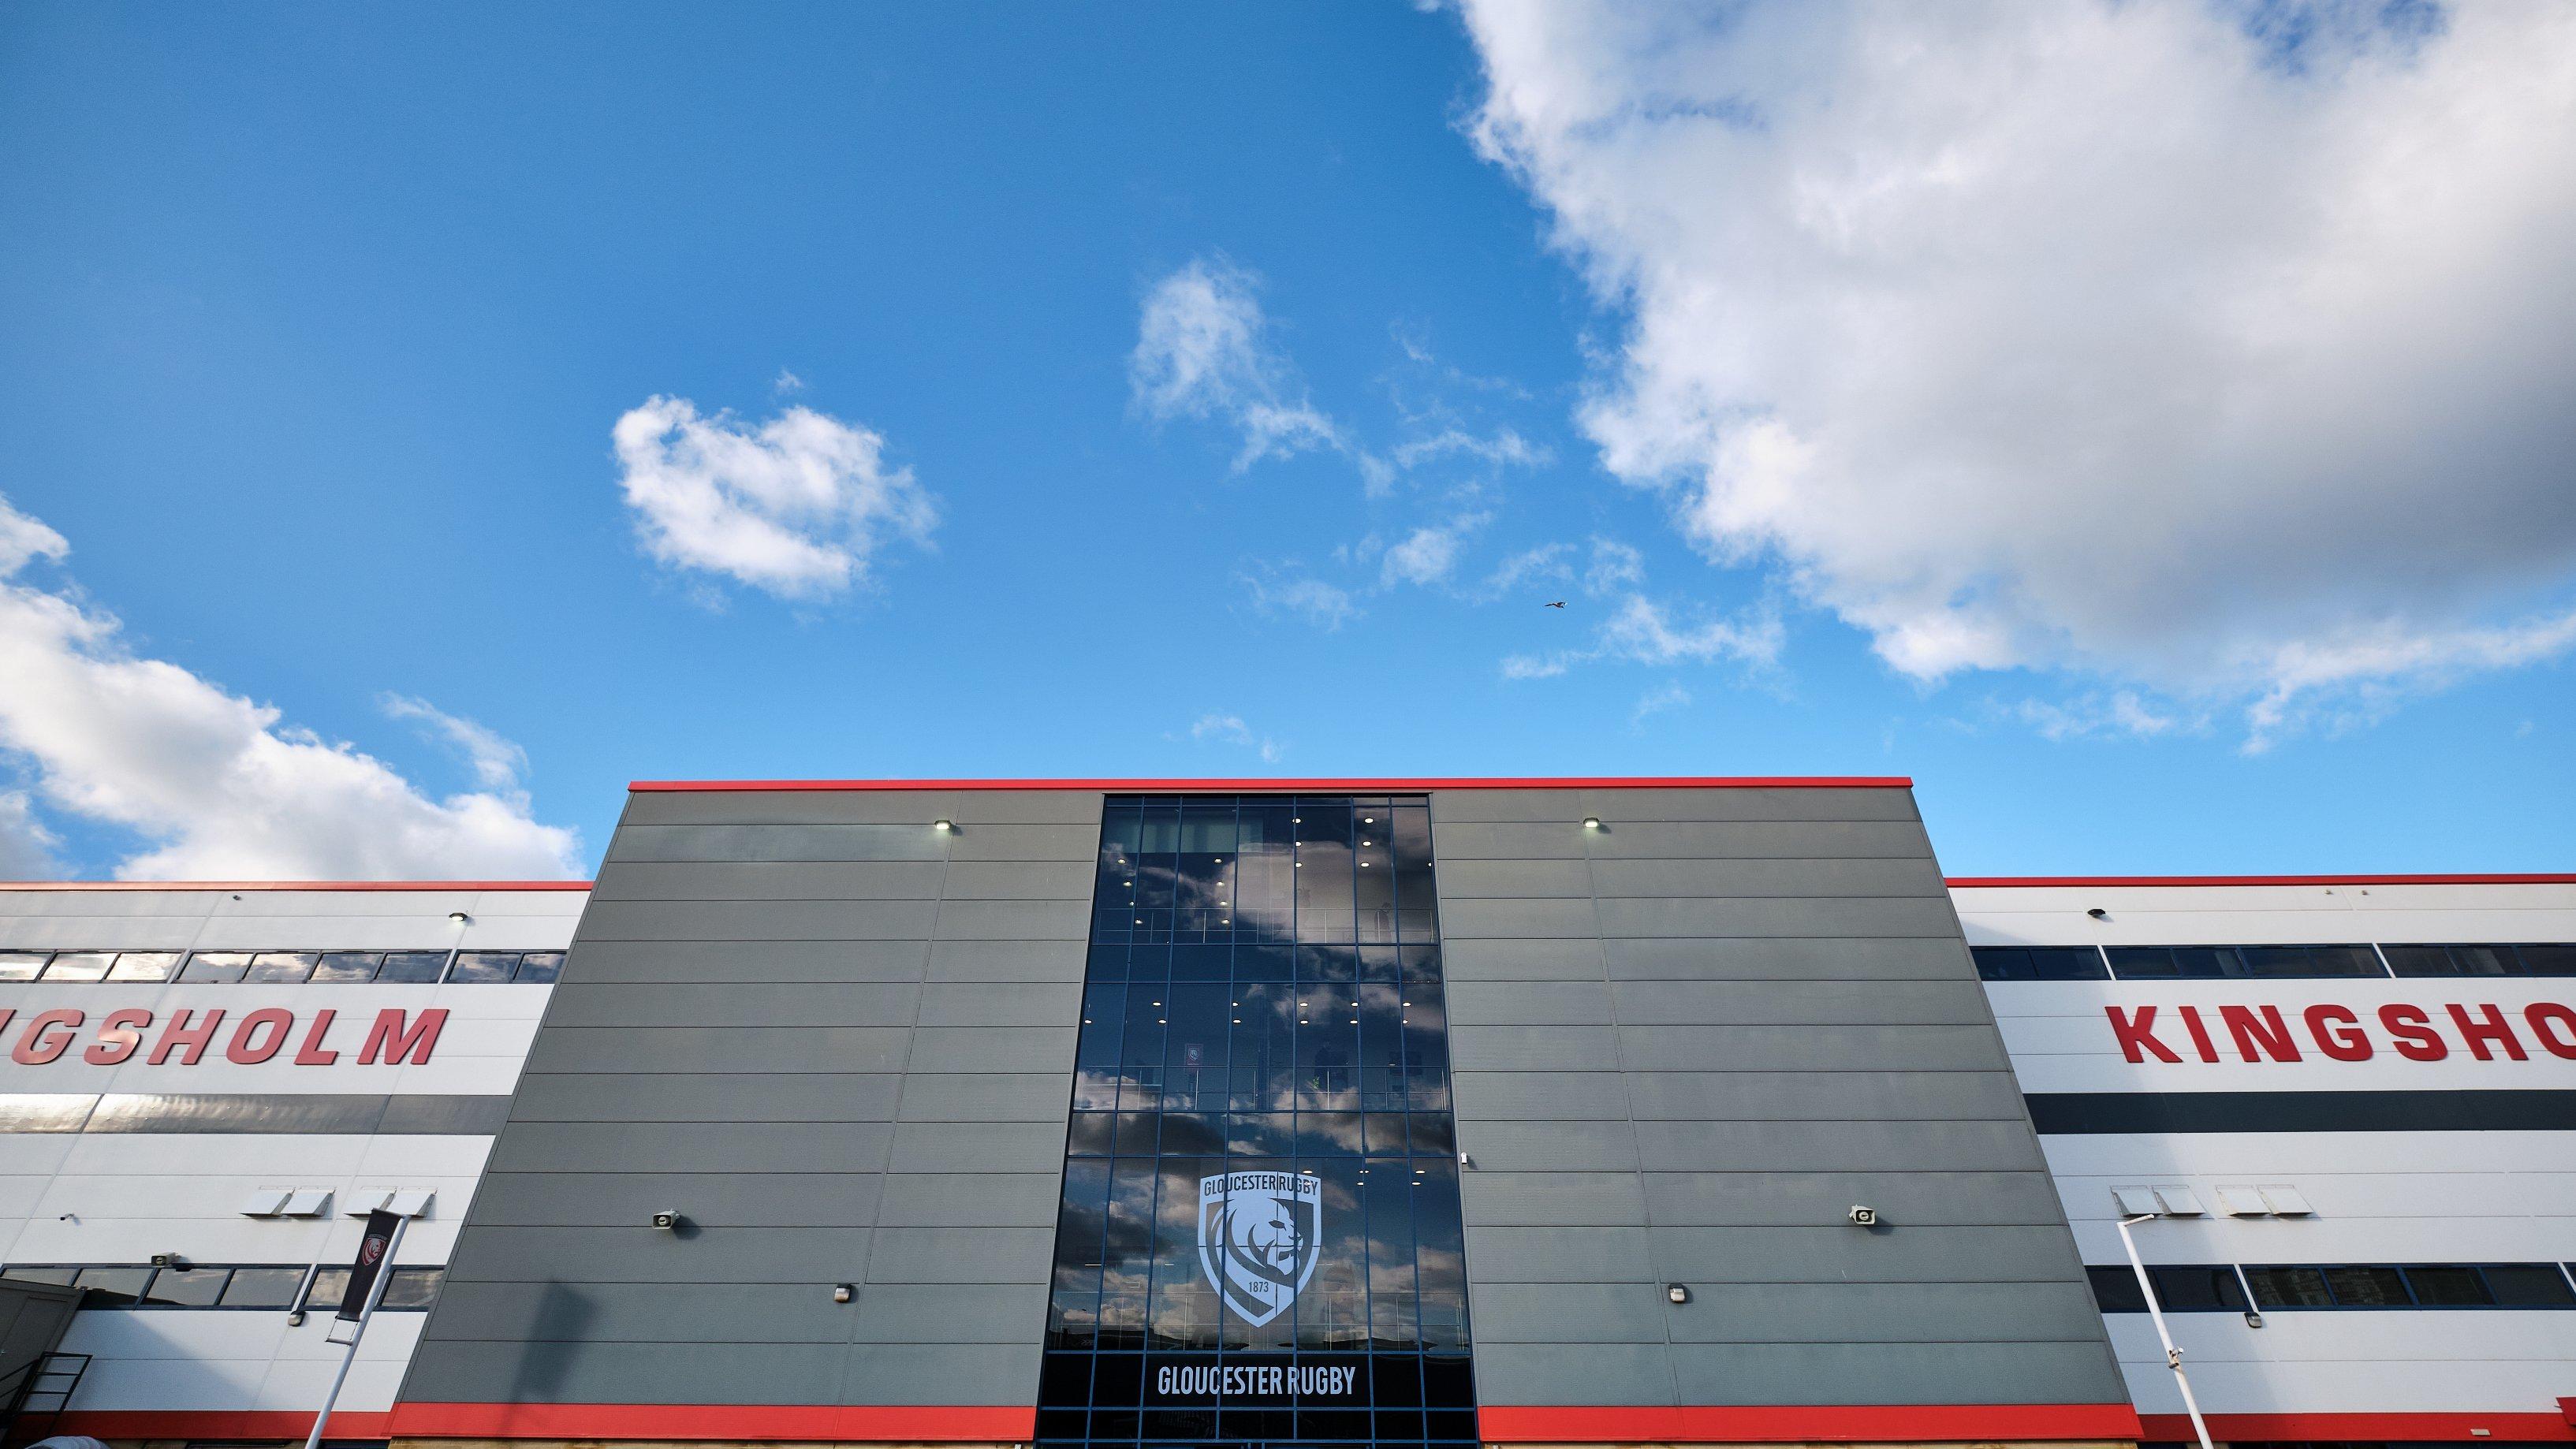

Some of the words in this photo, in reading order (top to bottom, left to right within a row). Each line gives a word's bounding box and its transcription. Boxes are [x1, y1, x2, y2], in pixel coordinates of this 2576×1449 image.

[0, 1008, 450, 1066] GSHOLM
[2104, 1002, 2576, 1063] KINGSHO
[1204, 1175, 1277, 1196] GLOUCESTER
[1279, 1175, 1318, 1196] RUGBY
[1248, 1281, 1269, 1293] 1873
[1158, 1366, 1283, 1395] GLOUCESTER
[1288, 1366, 1356, 1395] RUGBY
